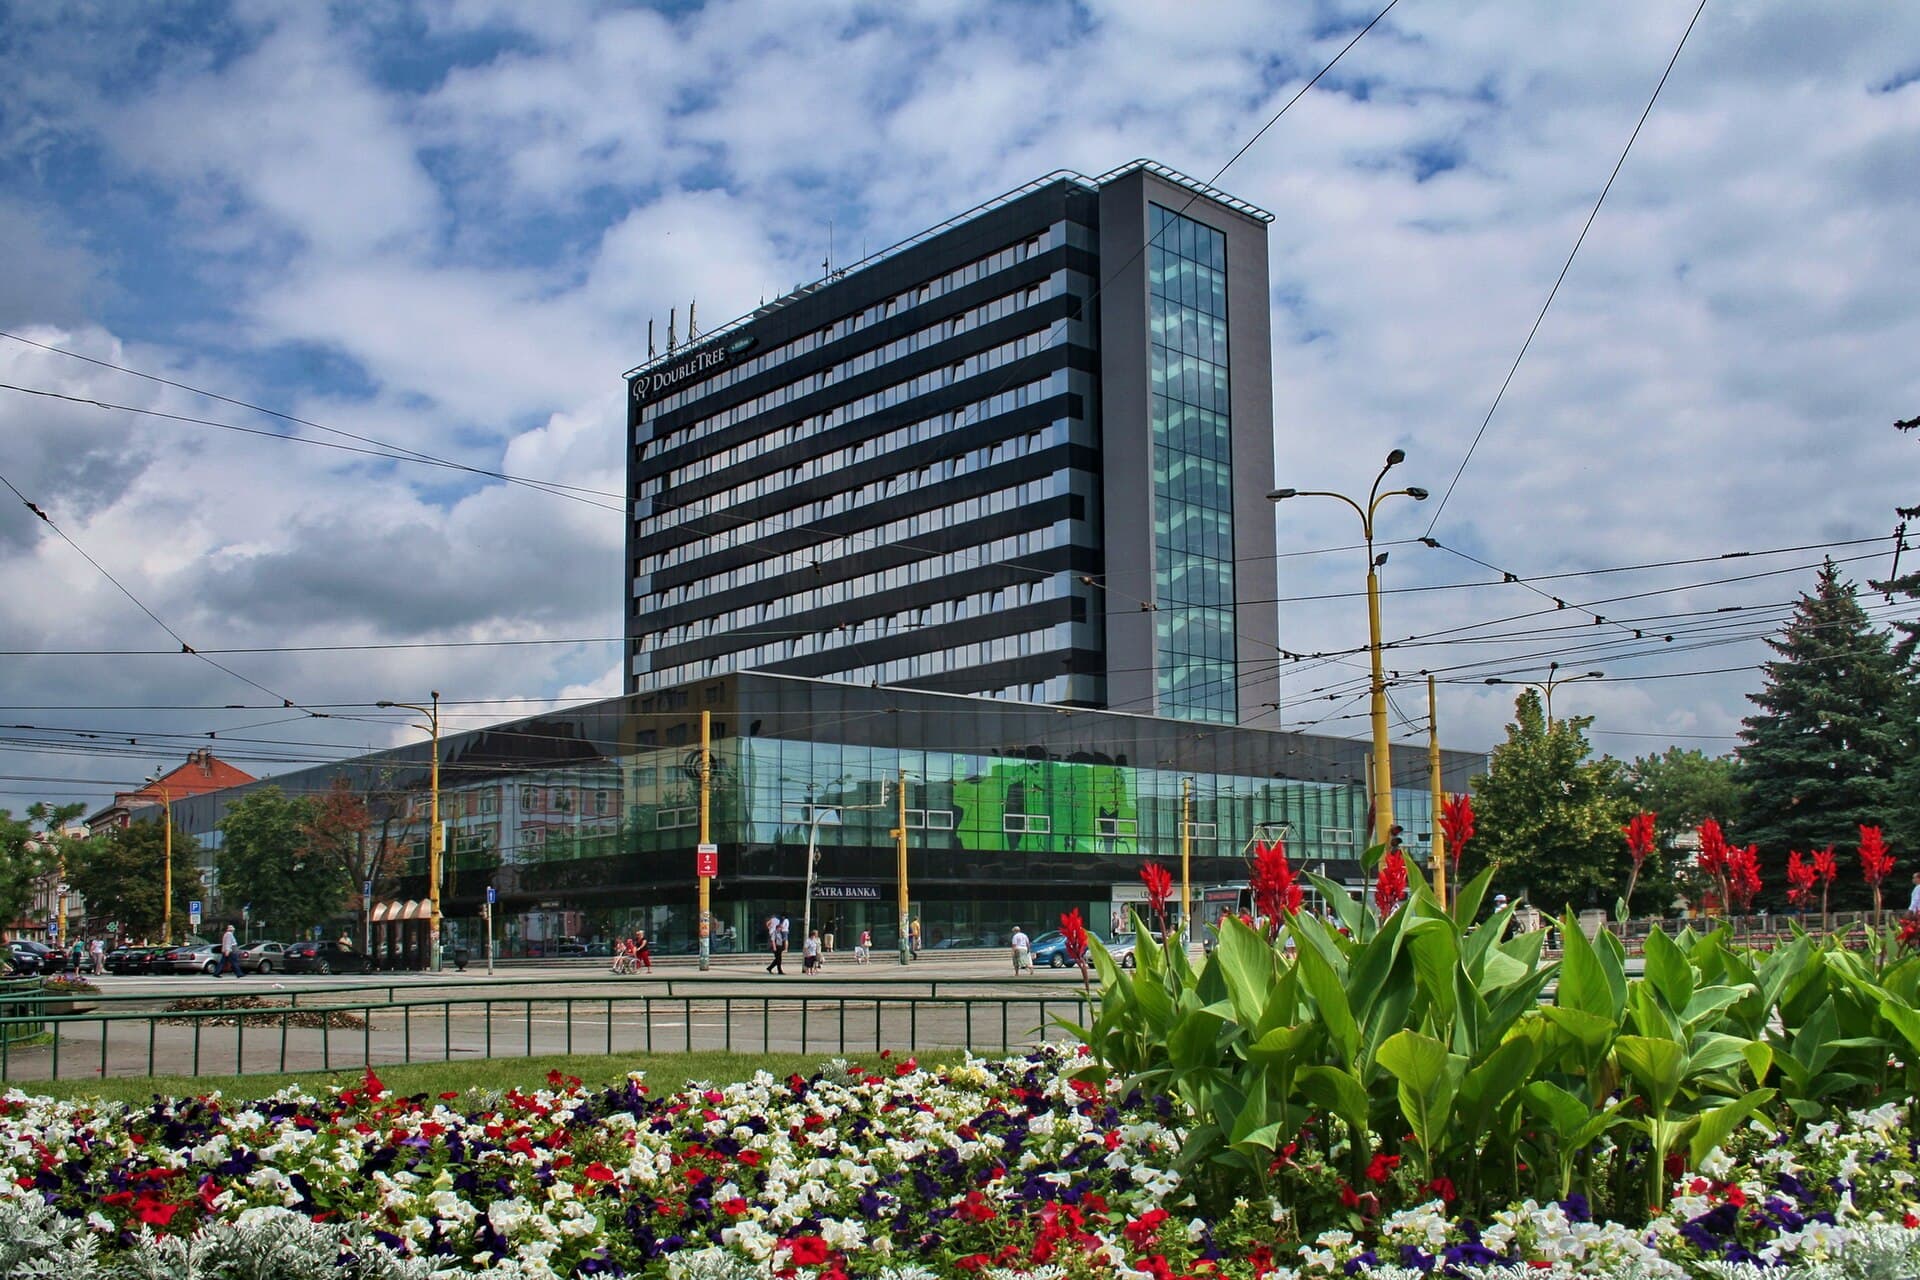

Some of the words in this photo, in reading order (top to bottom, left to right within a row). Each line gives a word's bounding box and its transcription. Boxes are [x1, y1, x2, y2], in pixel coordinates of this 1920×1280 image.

[653, 347, 725, 391] DOUBLETREE
[845, 887, 877, 897] BANKA
[192, 903, 199, 911] P
